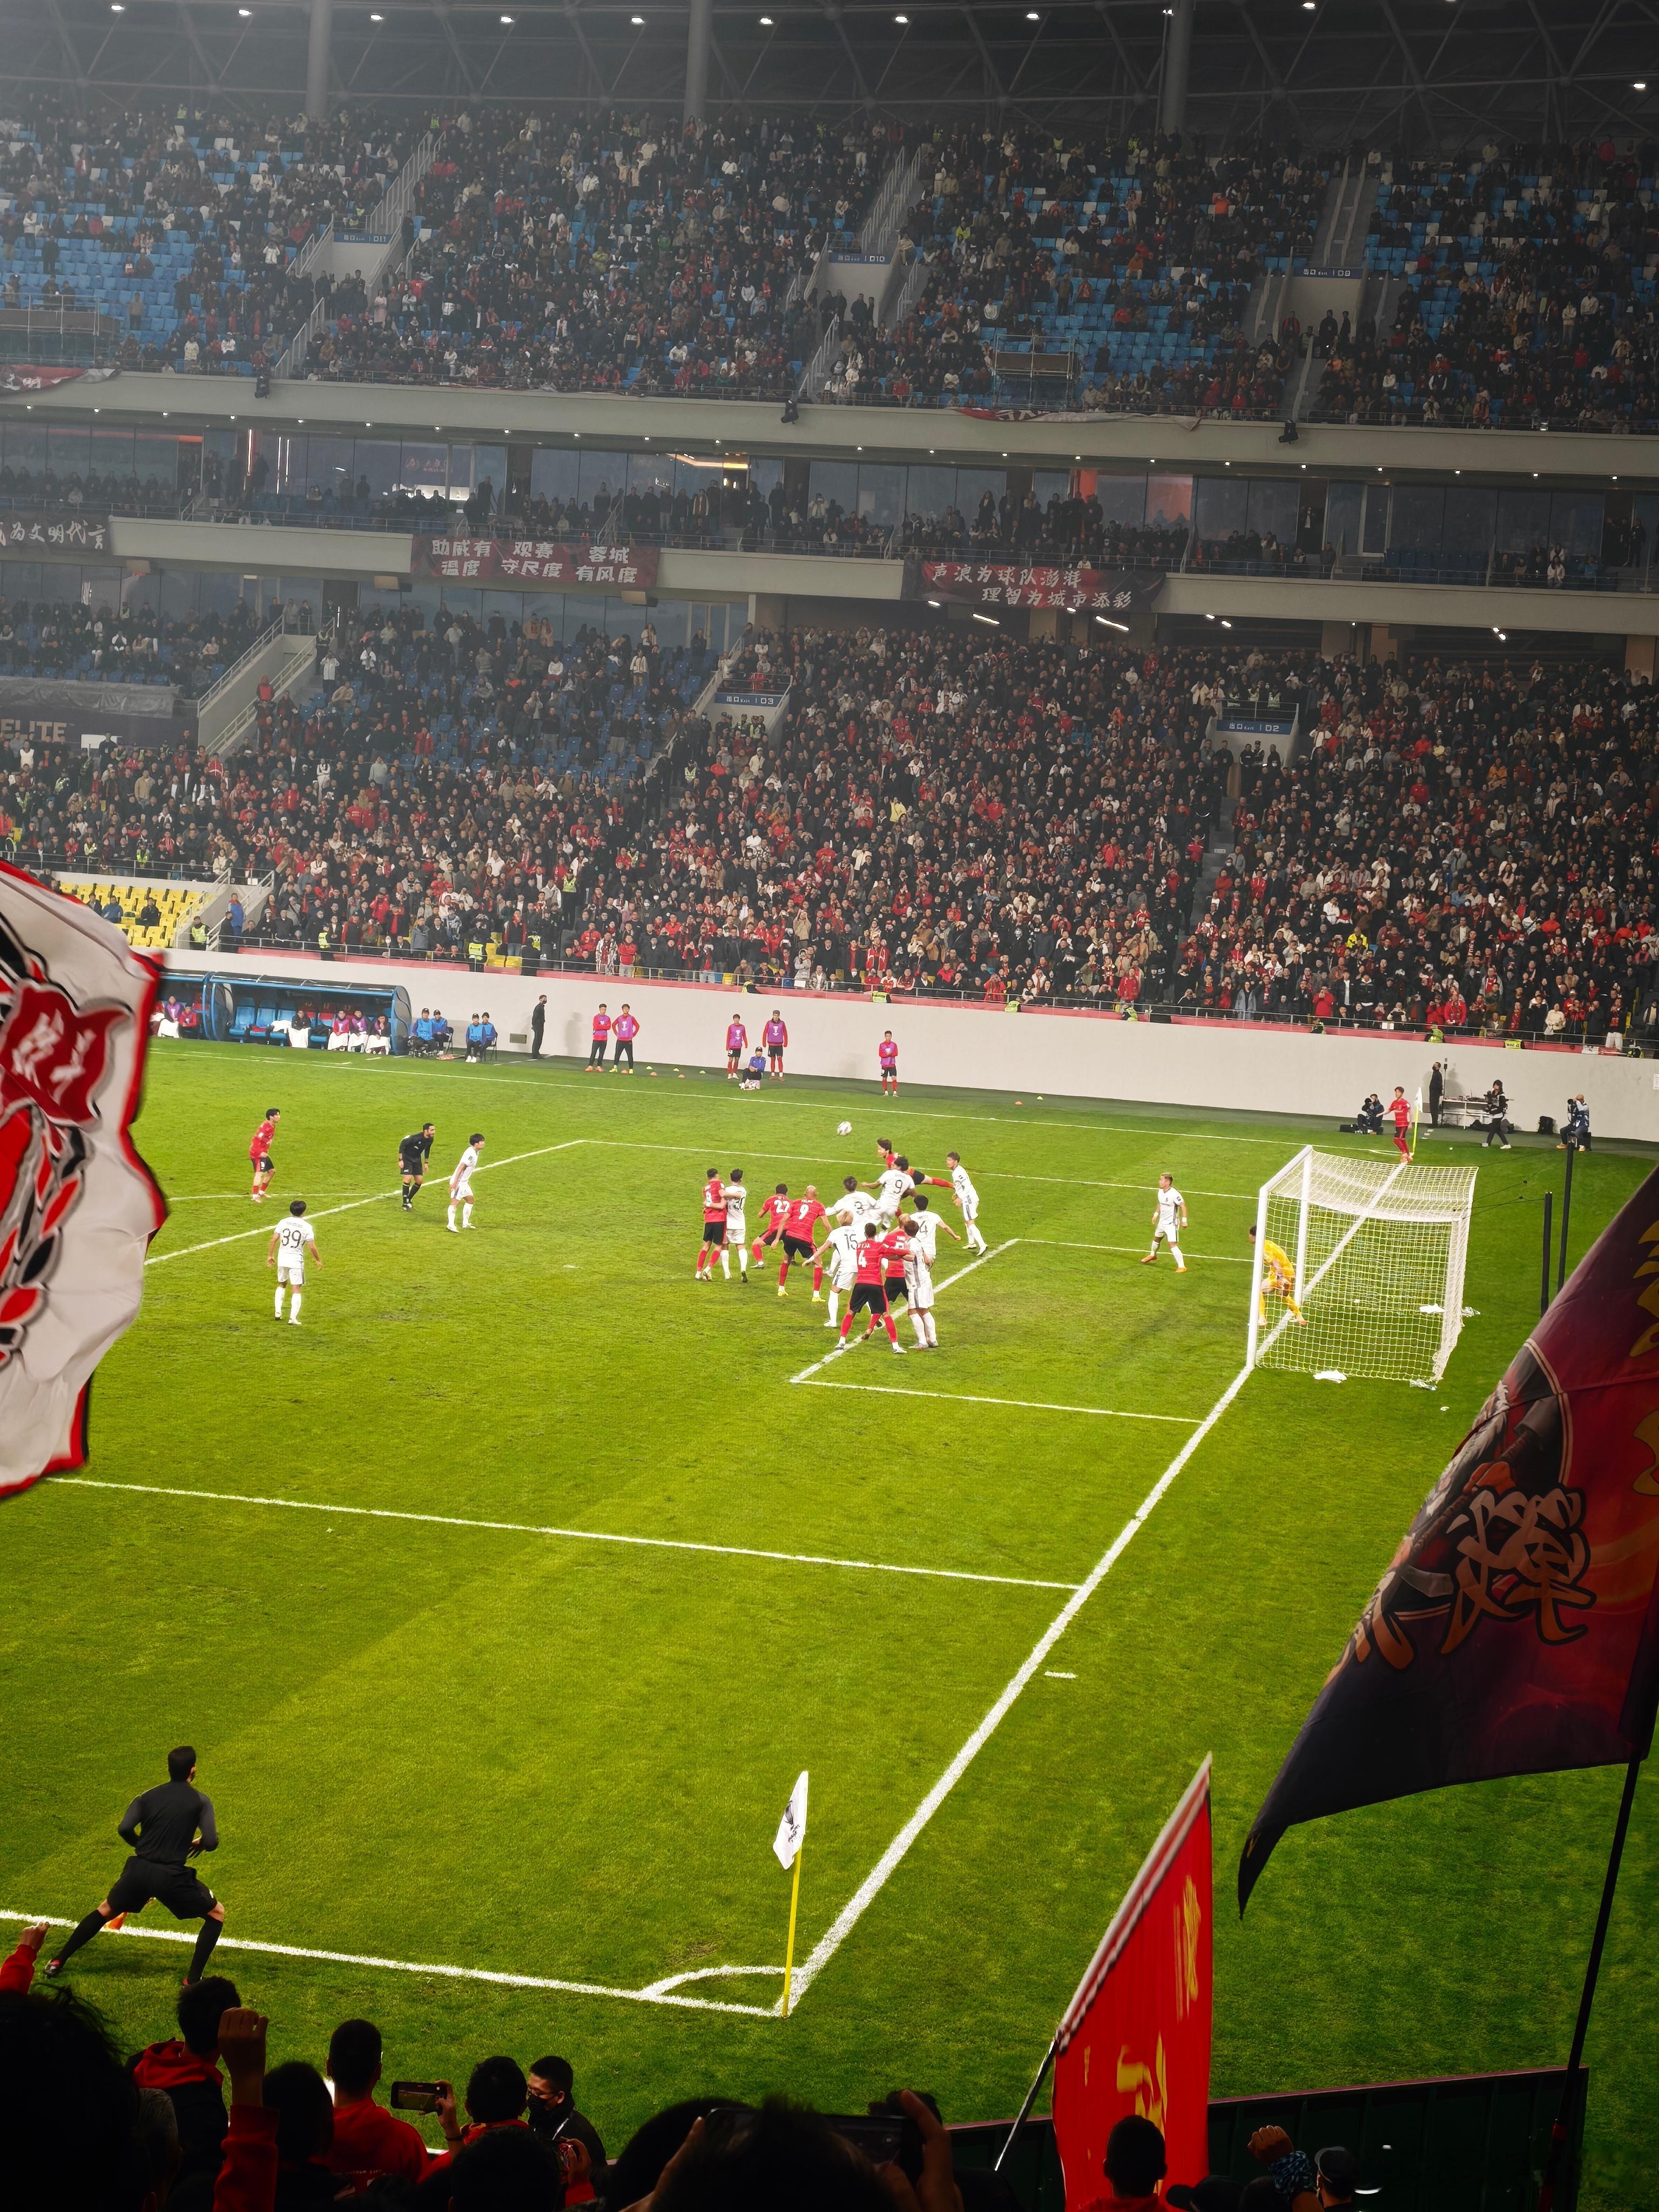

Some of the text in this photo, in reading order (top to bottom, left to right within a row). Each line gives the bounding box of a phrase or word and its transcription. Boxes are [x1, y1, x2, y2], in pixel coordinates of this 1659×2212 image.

[432, 539, 630, 564] 助威有 观赛 蓉城
[441, 558, 638, 583] 温度 守尺度 有风度
[932, 562, 1082, 589] 声浪为球队澎湃
[981, 587, 1132, 609] 理智为城市添彩
[1, 719, 68, 743] ELITE
[893, 1179, 903, 1194] 9
[798, 1204, 810, 1220] 9
[854, 1201, 865, 1215] 3
[919, 1220, 928, 1235] 4
[281, 1228, 301, 1249] 39
[844, 1233, 858, 1251] 15
[858, 1249, 867, 1268] 4
